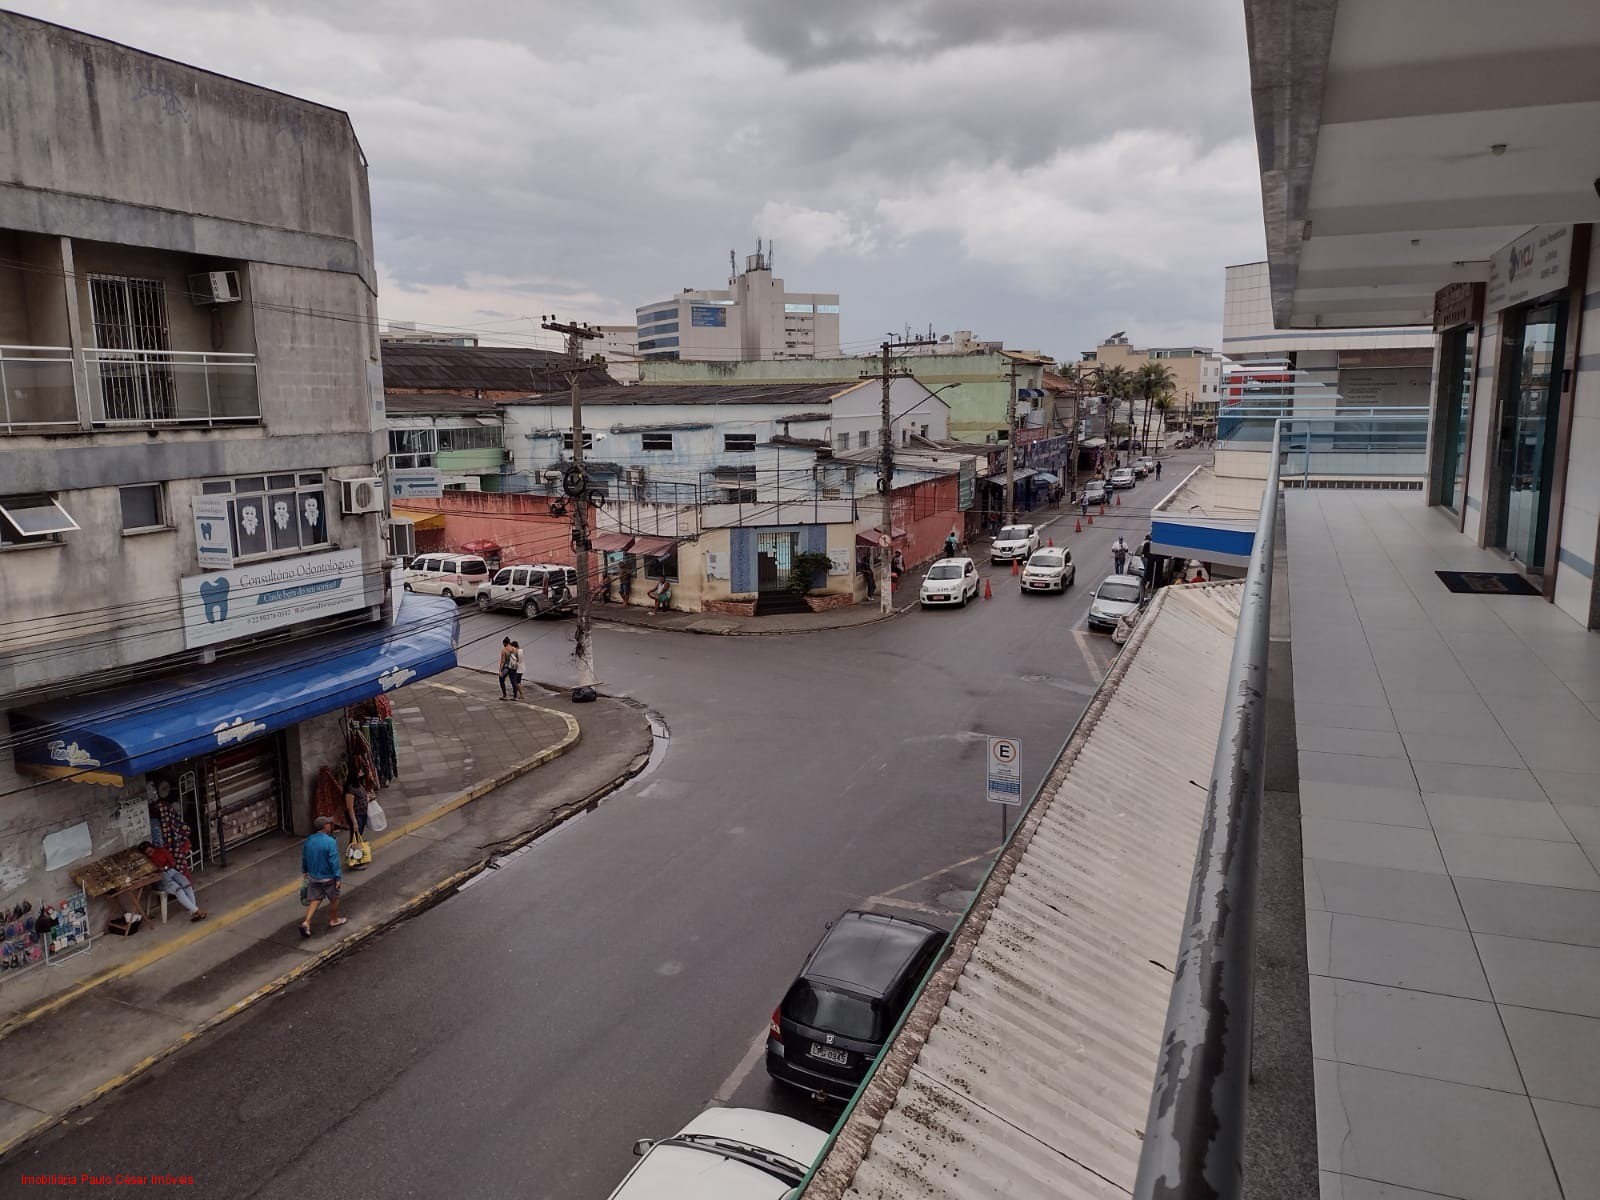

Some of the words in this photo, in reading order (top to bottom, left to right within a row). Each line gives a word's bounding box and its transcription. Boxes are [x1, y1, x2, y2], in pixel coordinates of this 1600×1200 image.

[240, 569, 294, 587] Consultório
[297, 559, 355, 577] Odontológico
[999, 744, 1010, 758] E
